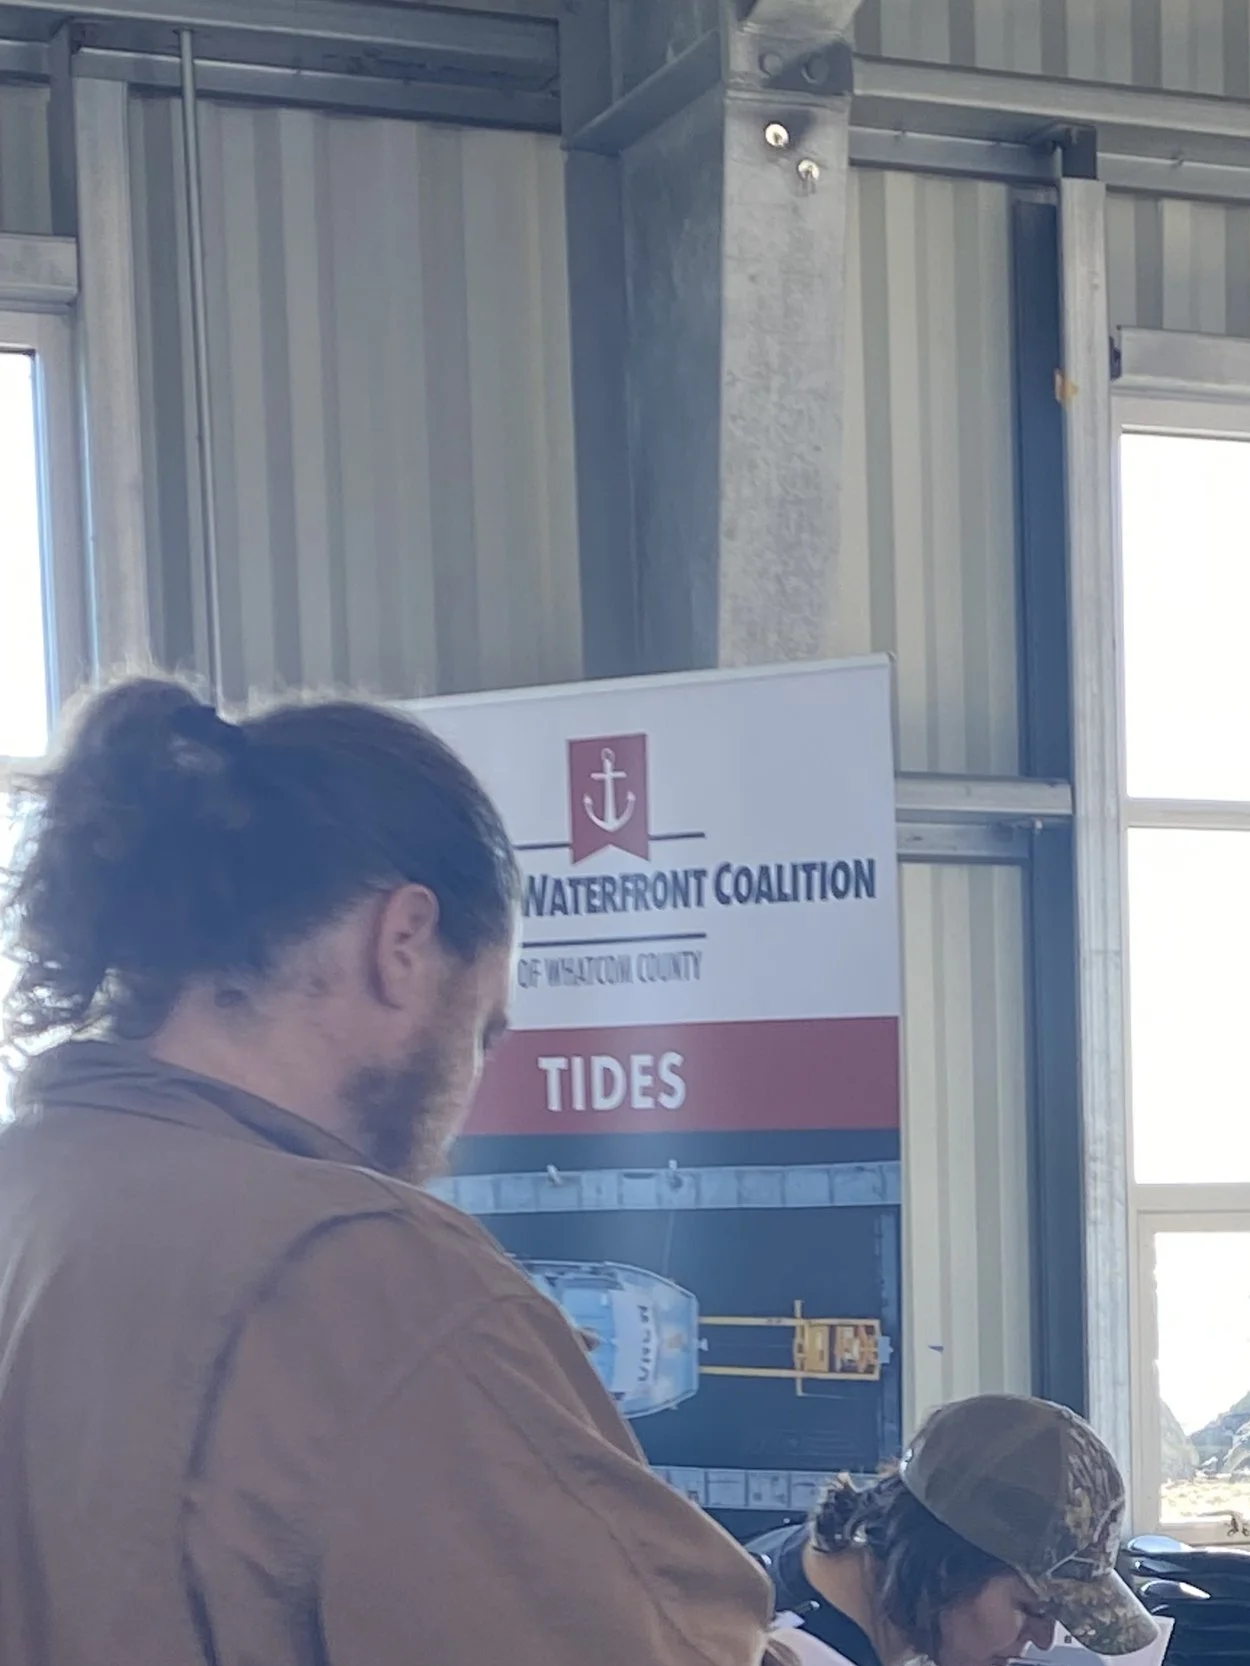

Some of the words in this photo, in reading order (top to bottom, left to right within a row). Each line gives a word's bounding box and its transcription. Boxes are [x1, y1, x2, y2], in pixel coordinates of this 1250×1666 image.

[523, 868, 706, 918] WATERFRONT
[714, 858, 876, 907] COALITION
[517, 958, 541, 989] OF
[545, 953, 633, 986] WHATCOM
[636, 949, 703, 984] COUNTY
[538, 1051, 687, 1112] TIDES
